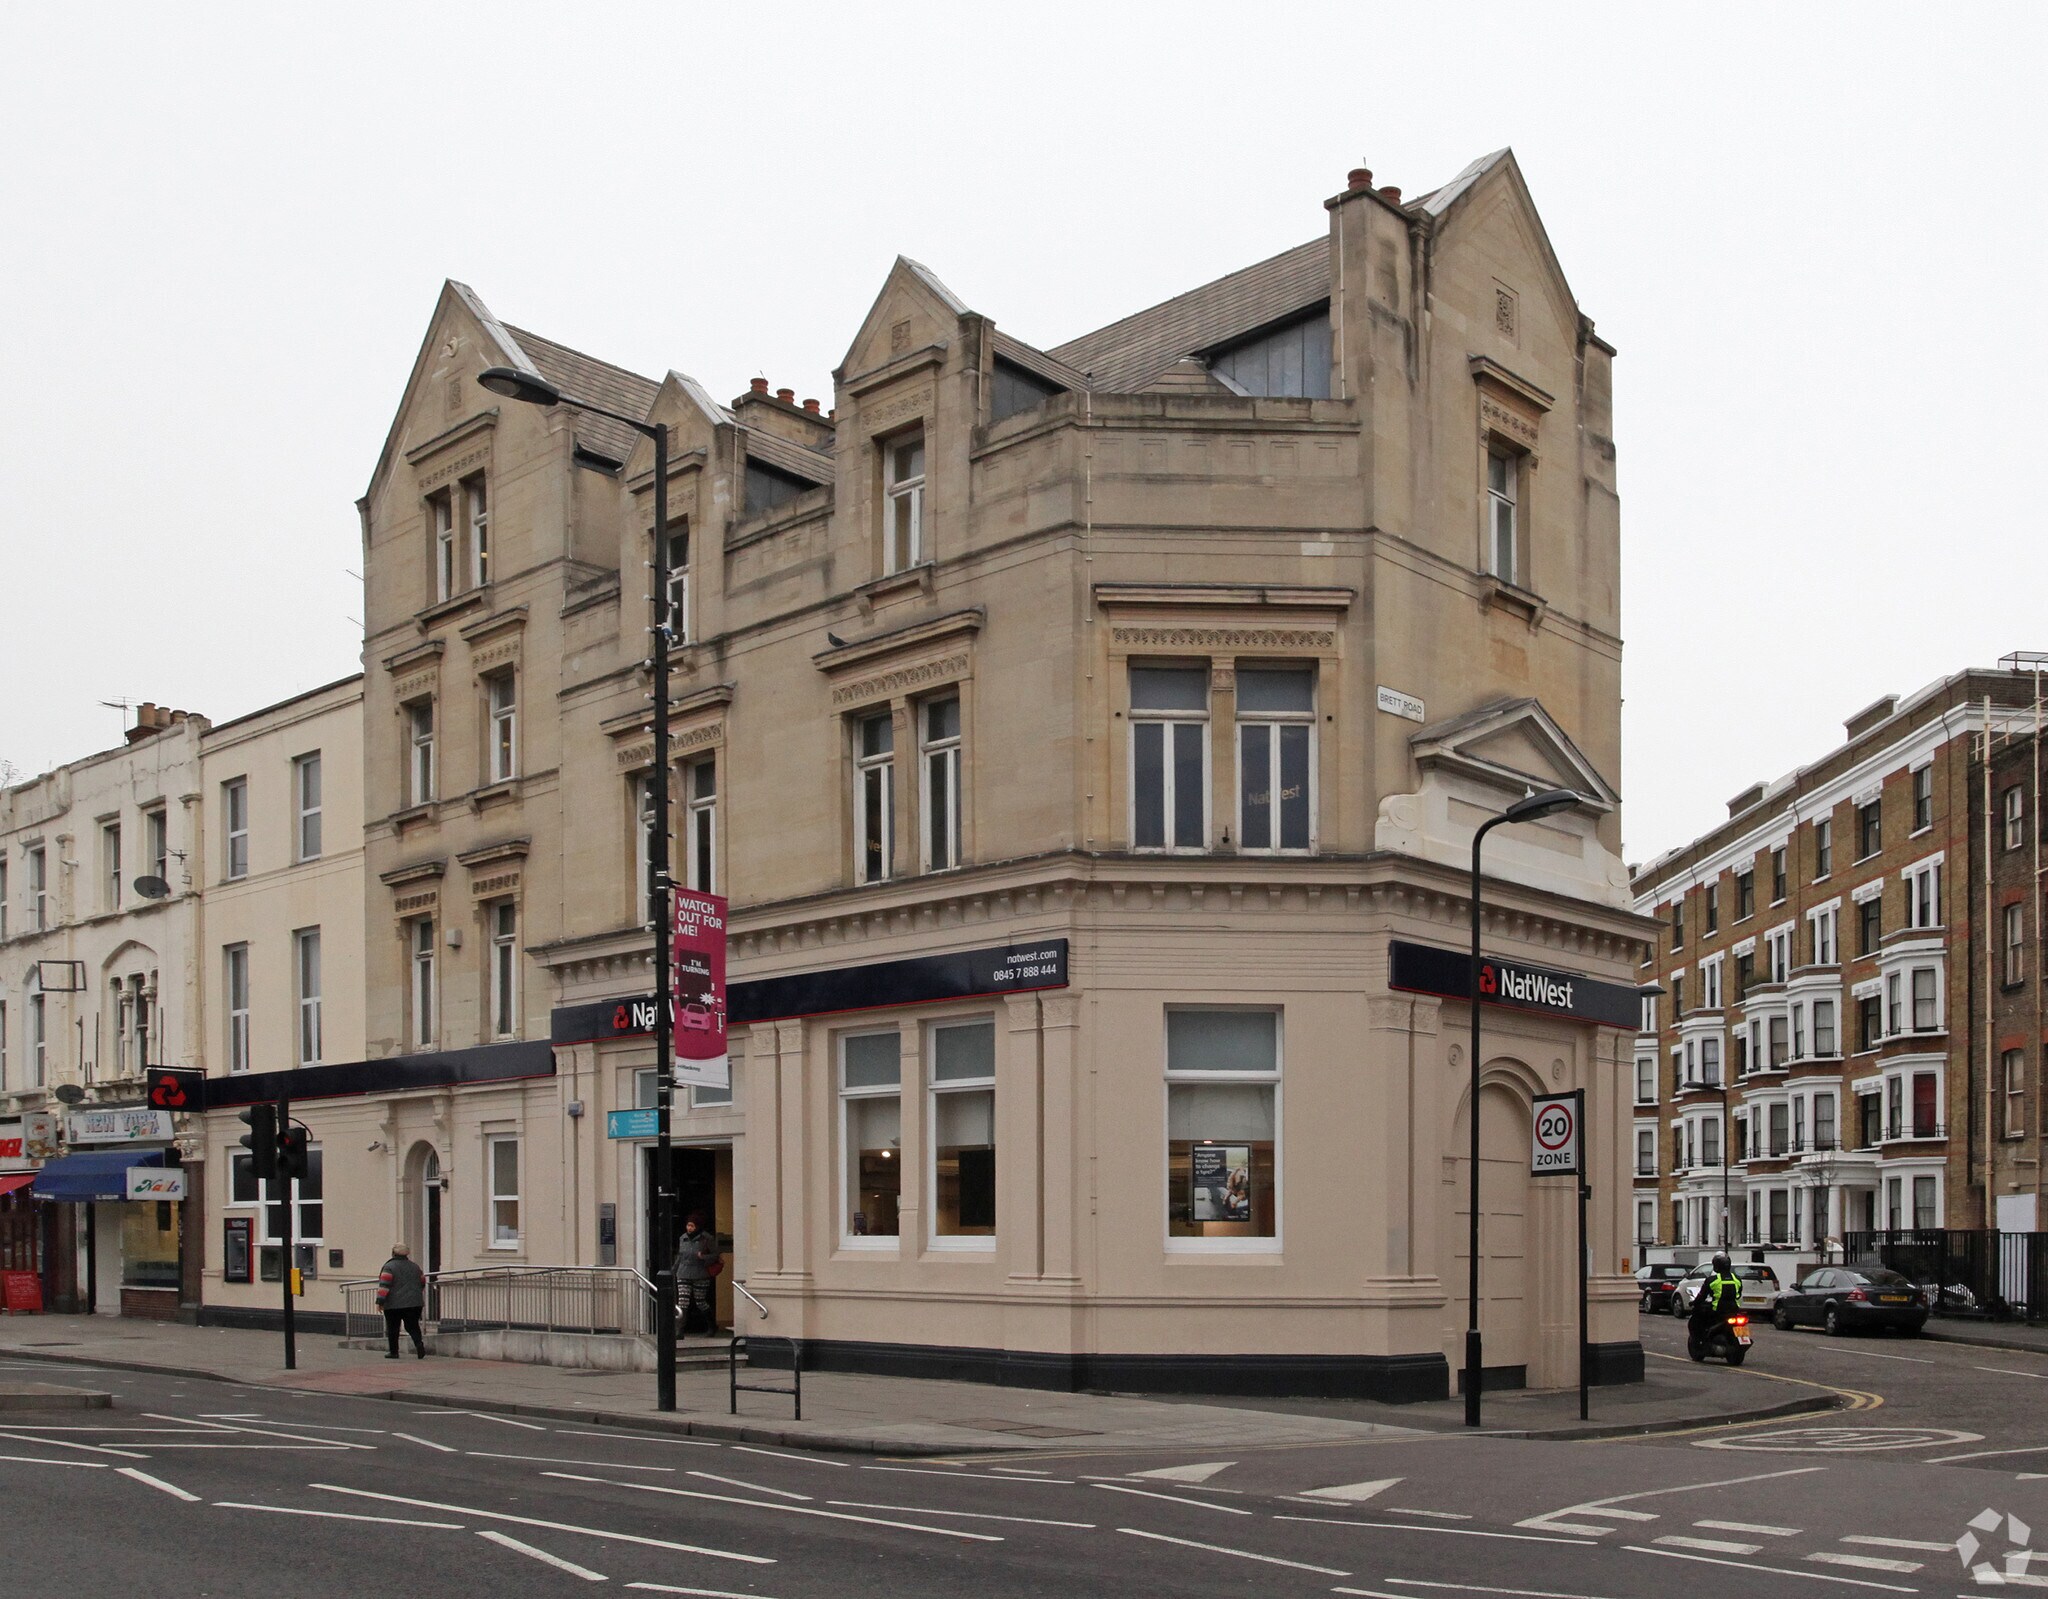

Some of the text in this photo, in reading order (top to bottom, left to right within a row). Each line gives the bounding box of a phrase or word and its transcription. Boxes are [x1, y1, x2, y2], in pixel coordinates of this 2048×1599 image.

[1380, 693, 1422, 714] BRETT ROAD
[1249, 785, 1300, 806] Natest
[678, 897, 714, 914] WATCH
[678, 910, 722, 929] OUT FOR
[678, 923, 698, 937] ME!
[1007, 950, 1057, 963] natwest.com
[681, 964, 710, 976] TURNING
[993, 964, 1057, 981] 0845 7 888 444
[1501, 968, 1574, 1009] NatWest
[85, 1114, 115, 1133] NEW
[129, 1125, 160, 1138] Nails
[1542, 1117, 1566, 1137] 20
[1536, 1152, 1571, 1166] ZONE
[134, 1179, 180, 1192] Nails
